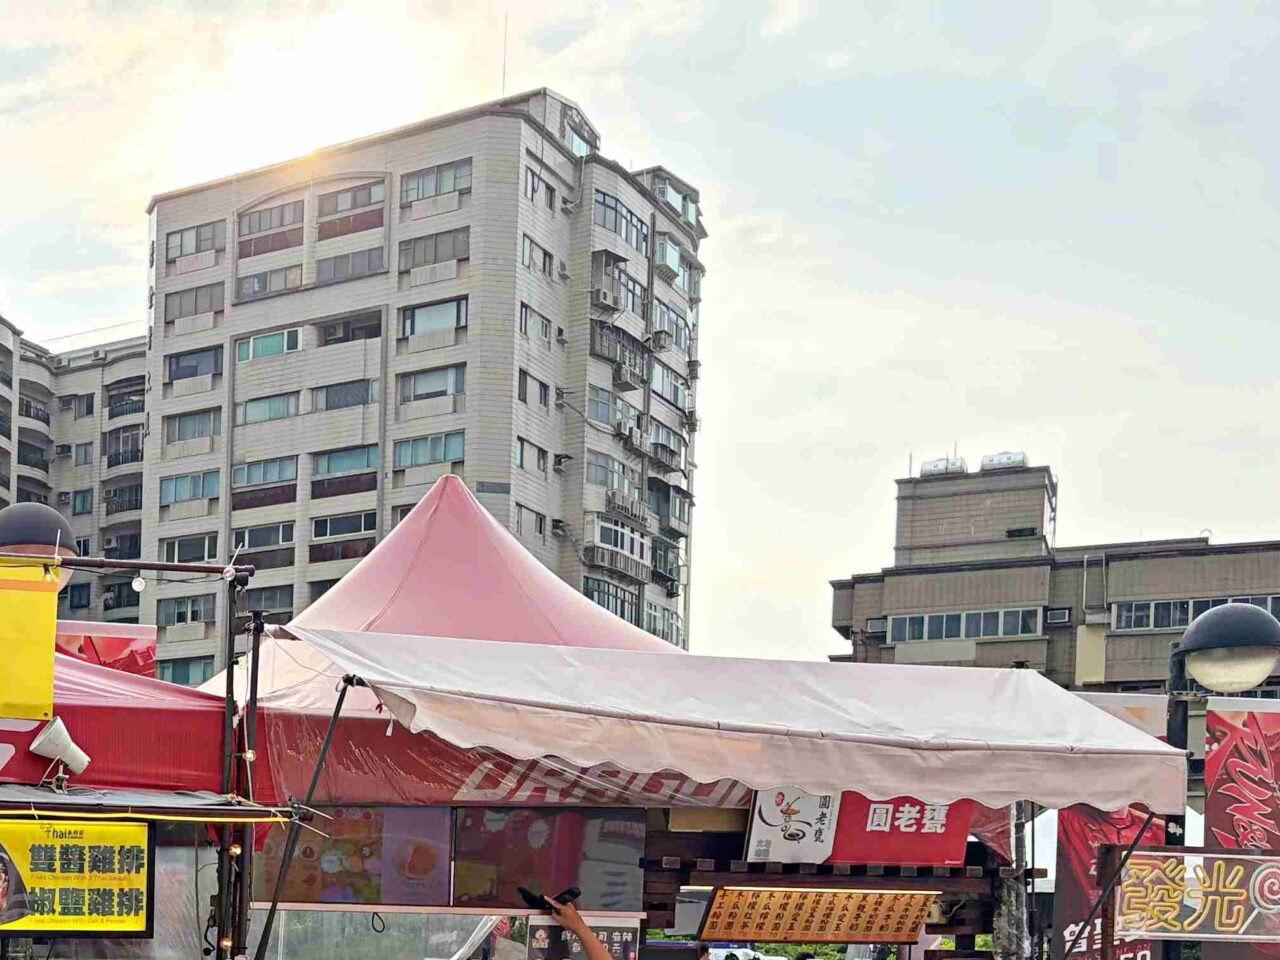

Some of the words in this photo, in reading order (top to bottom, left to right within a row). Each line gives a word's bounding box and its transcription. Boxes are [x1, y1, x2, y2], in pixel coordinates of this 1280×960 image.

[866, 803, 949, 834] 圓老甕
[29, 844, 145, 874] 雙醬雞排
[29, 887, 144, 916] 椒鹽雞排
[1121, 858, 1247, 931] 發光
